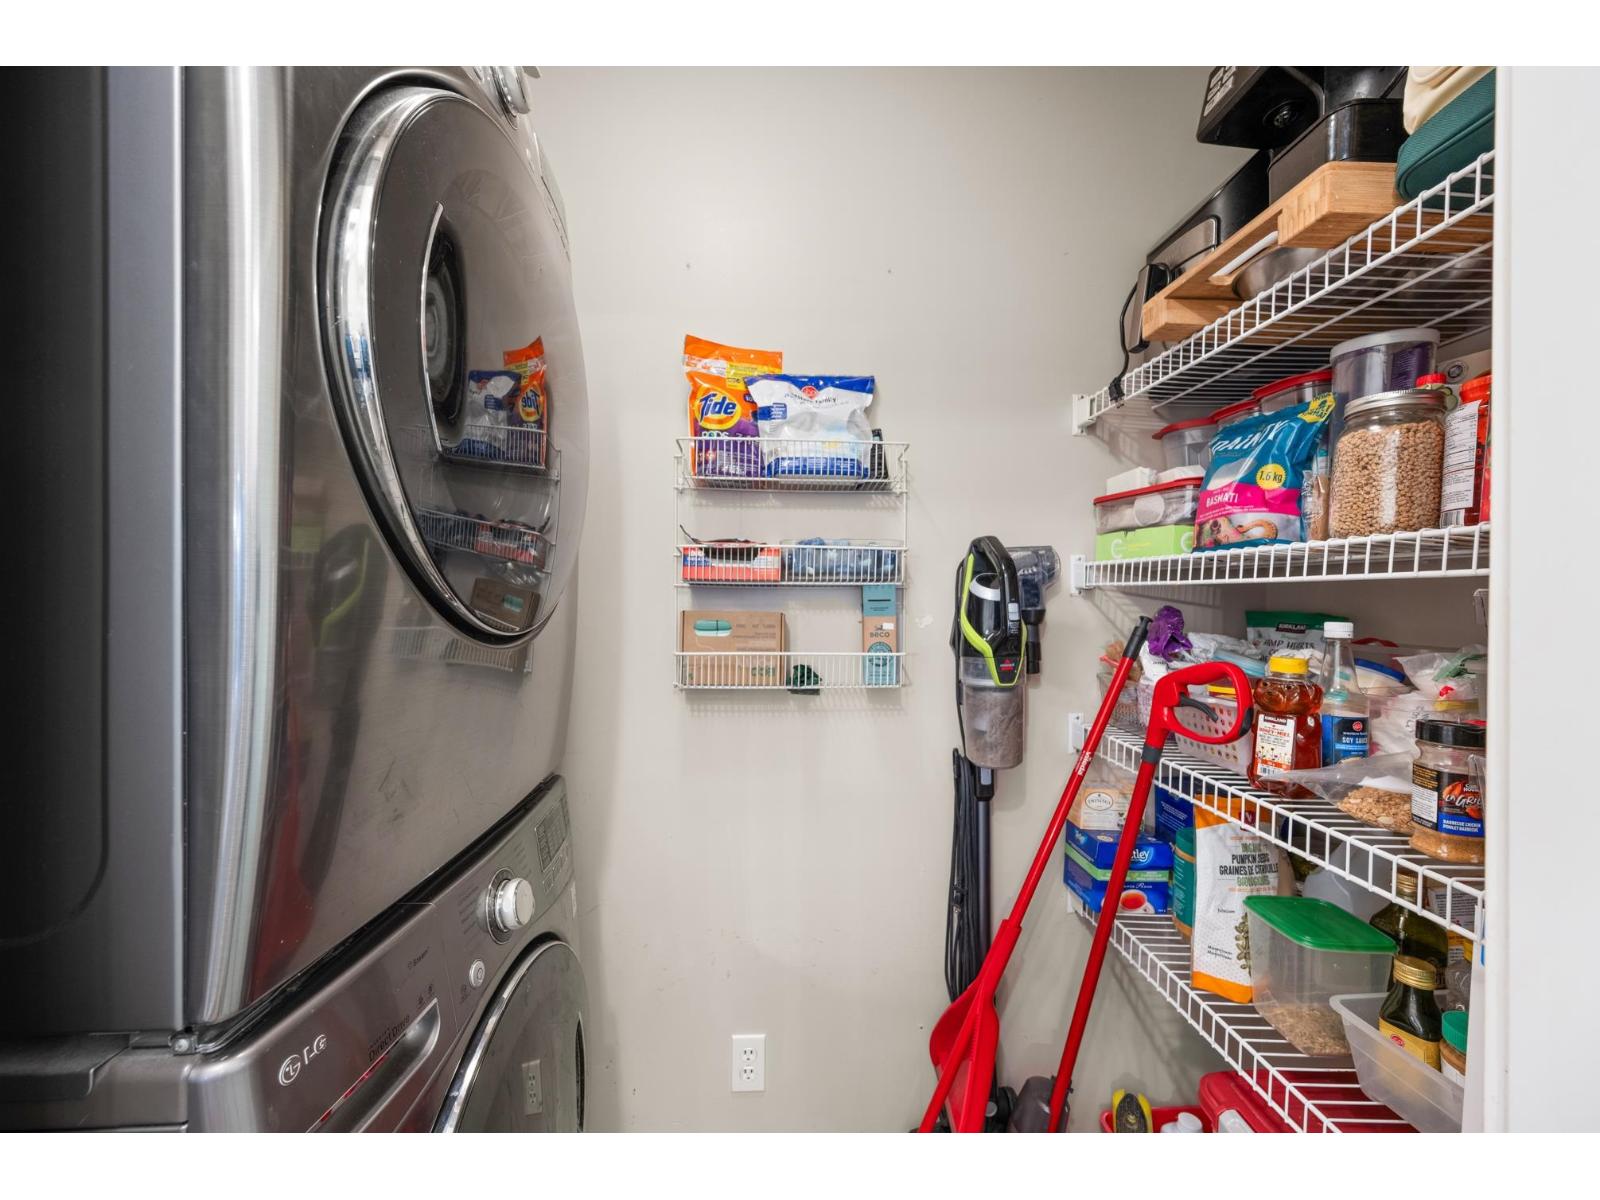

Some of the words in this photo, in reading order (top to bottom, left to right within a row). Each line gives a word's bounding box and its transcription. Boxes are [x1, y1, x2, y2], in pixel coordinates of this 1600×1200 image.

[699, 391, 737, 423] Tide
[1259, 470, 1272, 481] 1.6
[1272, 472, 1283, 484] kg
[1231, 854, 1257, 865] PUMPKIN
[1219, 865, 1248, 876] GRAINES
